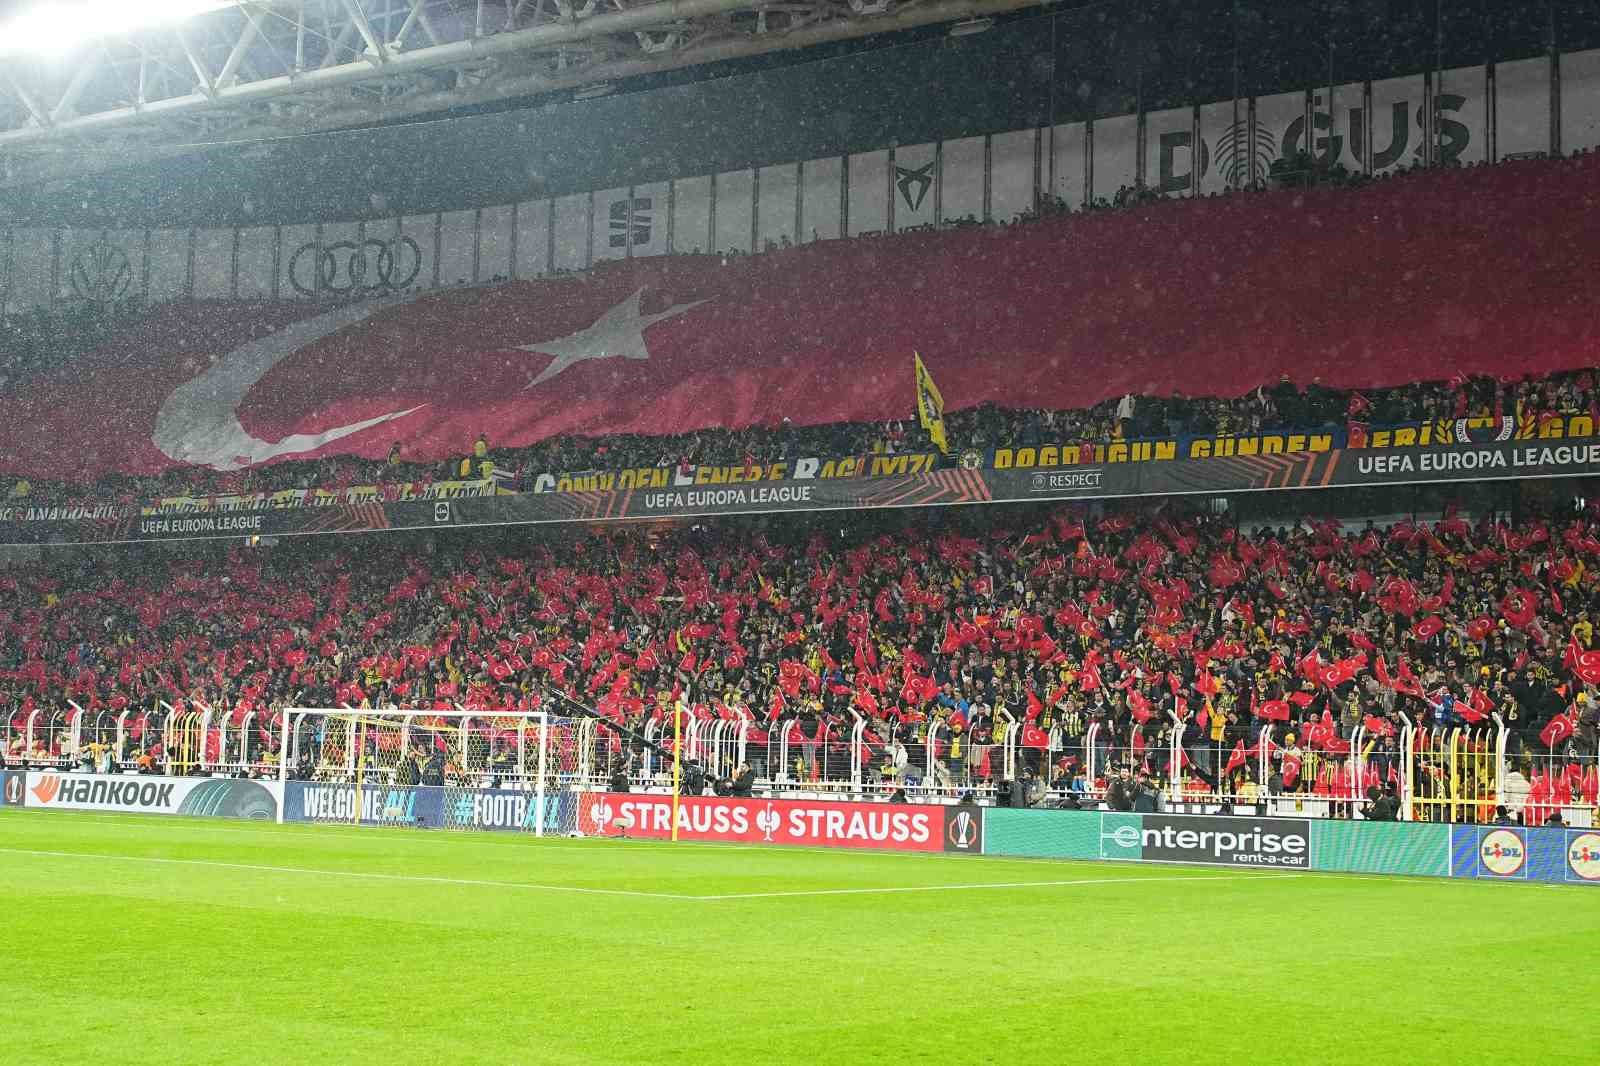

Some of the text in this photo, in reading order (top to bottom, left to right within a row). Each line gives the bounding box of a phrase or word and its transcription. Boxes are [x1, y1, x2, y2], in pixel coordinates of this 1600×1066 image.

[1358, 445, 1600, 474] UEFA EUROPA LEAGUE
[1050, 473, 1101, 487] RESPECT
[645, 486, 811, 508] UEFA EUROPA LEAGUE
[141, 515, 261, 534] UEFA EUROPA LEAGUE
[303, 787, 381, 820] WELCOME
[454, 793, 560, 829] #FOOTBALL
[620, 801, 930, 843] STRAUSS STRAUSS
[1113, 825, 1307, 857] enterprise
[1232, 852, 1305, 865] rent-a-car
